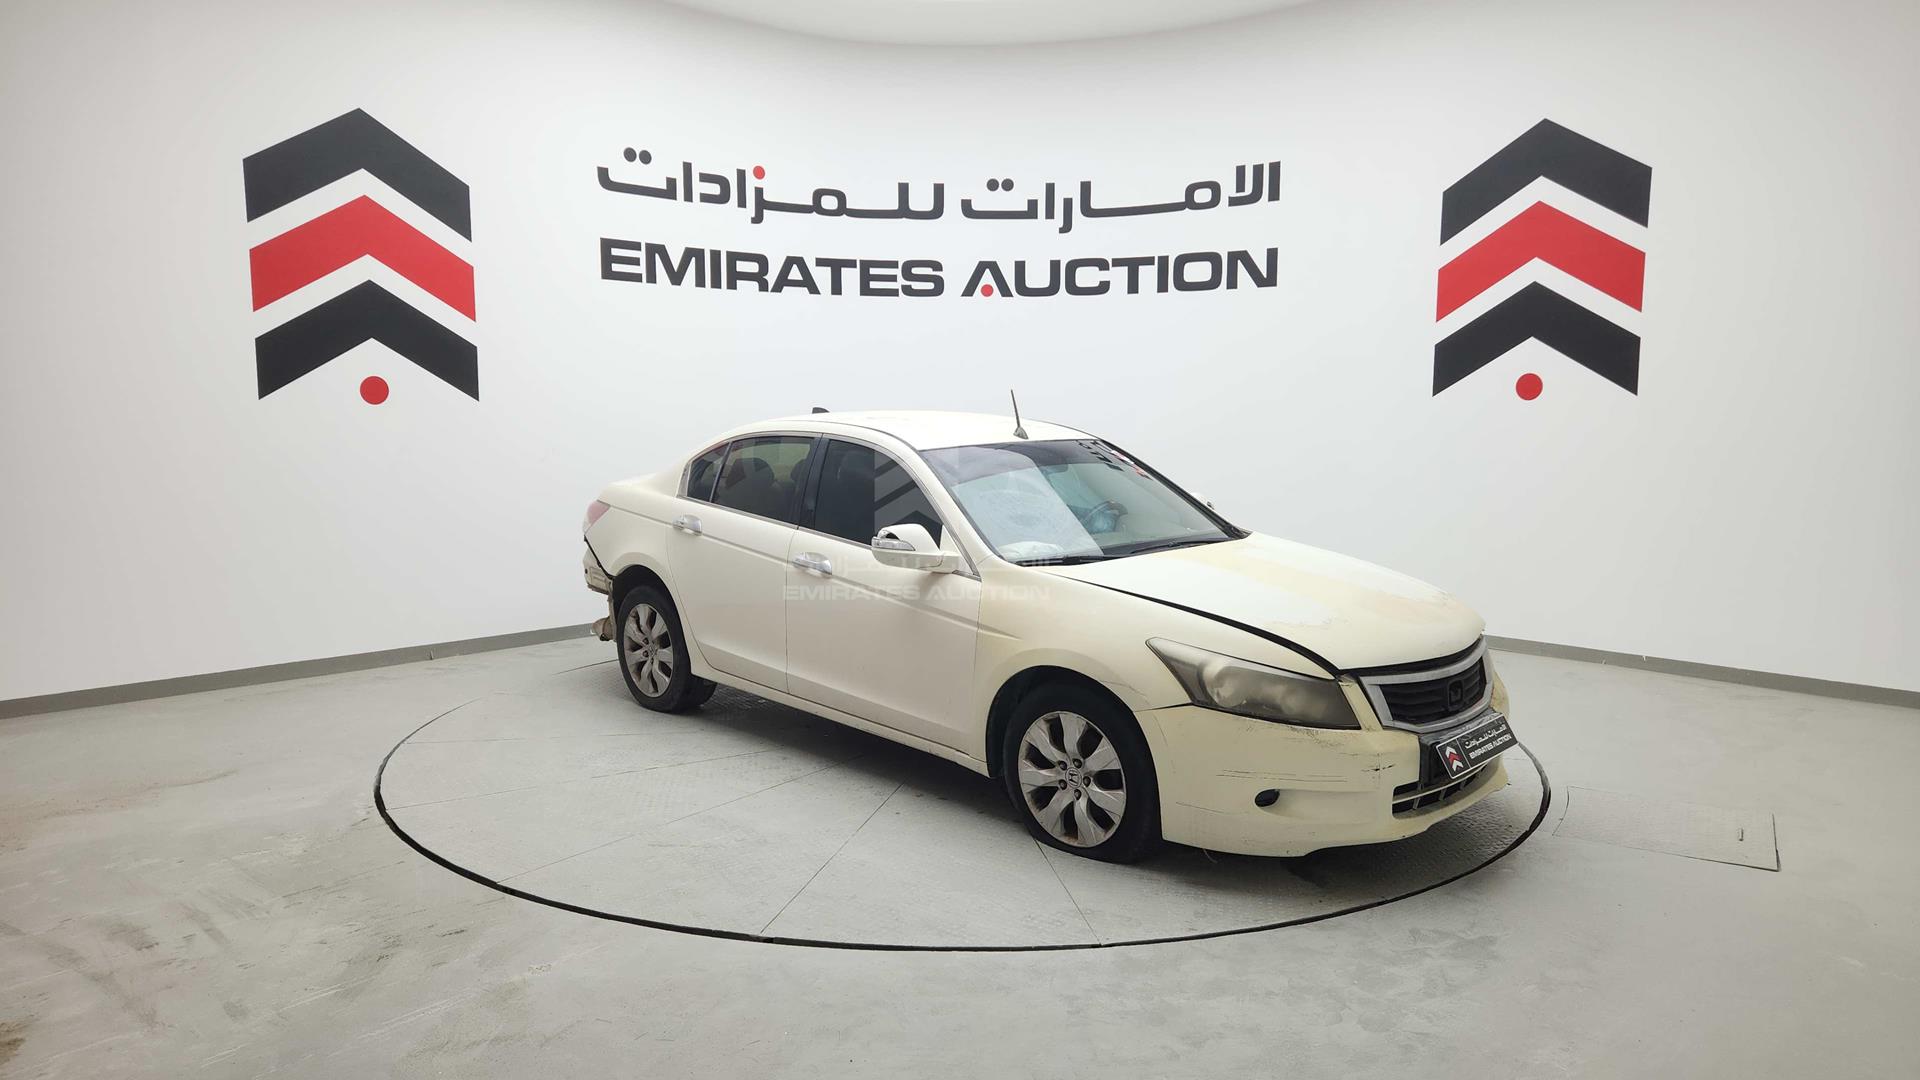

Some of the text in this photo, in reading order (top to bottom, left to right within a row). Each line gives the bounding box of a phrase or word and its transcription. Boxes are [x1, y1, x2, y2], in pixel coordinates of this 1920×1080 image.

[596, 147, 945, 225] للمزادات
[599, 237, 1279, 298] EMIRATES AUCTION
[1468, 733, 1512, 759] EMIRATES AUCTION
